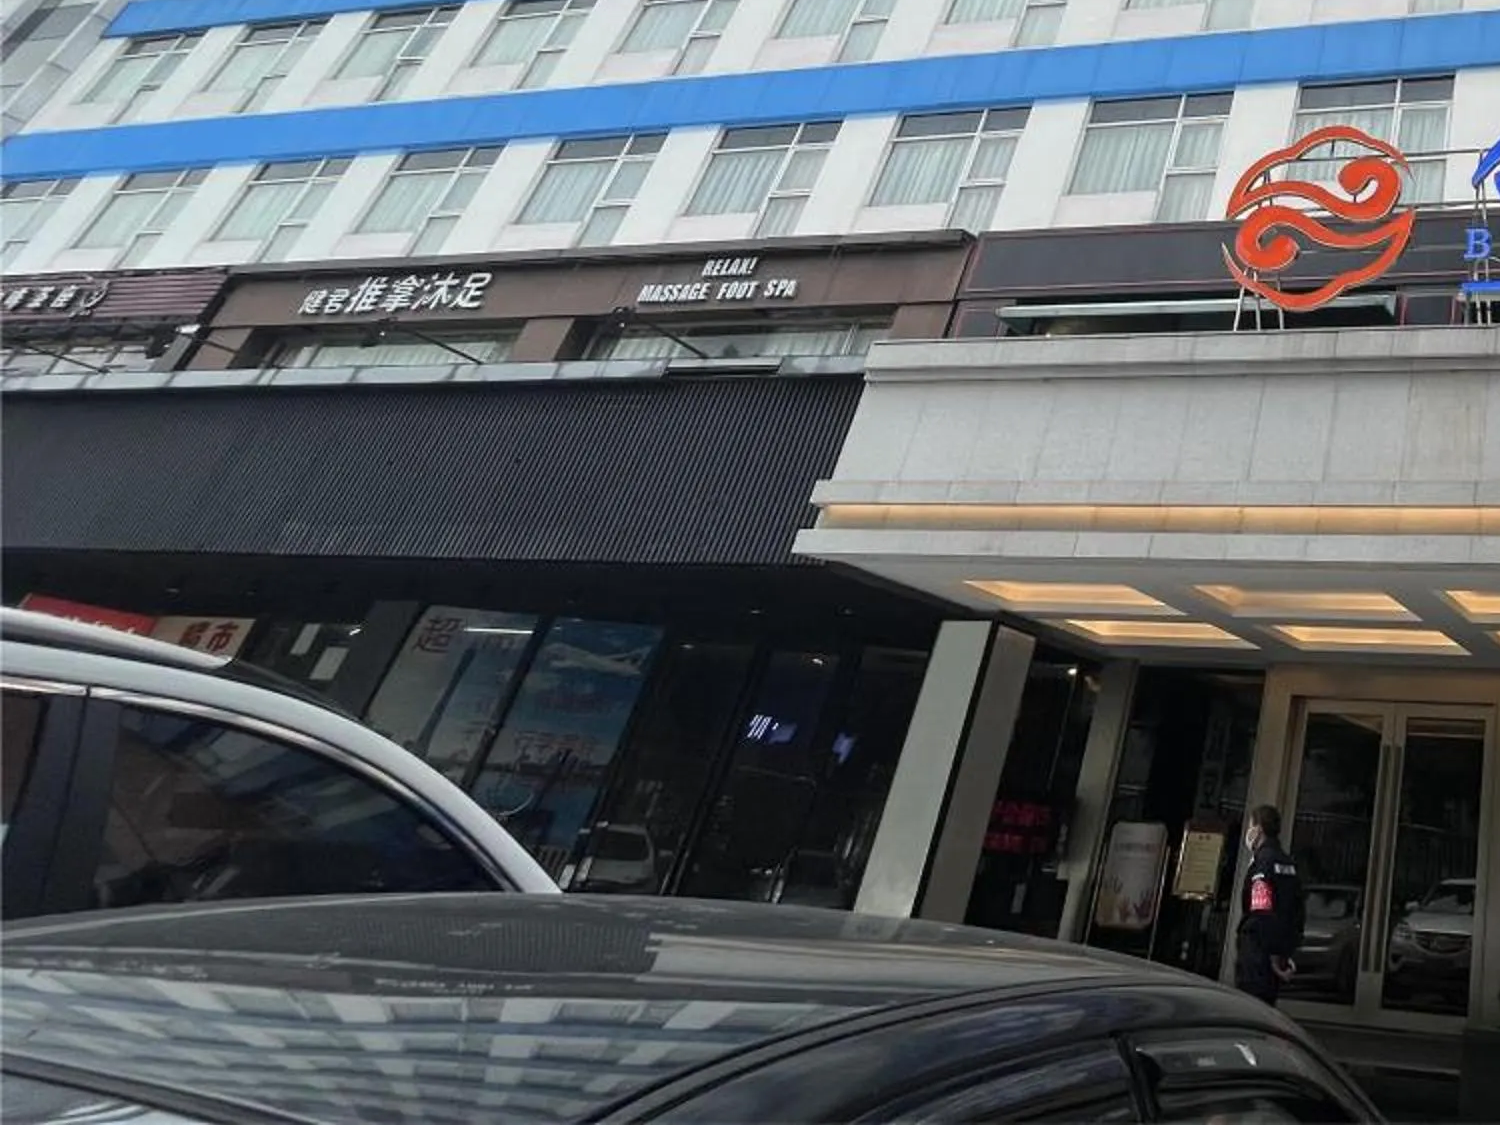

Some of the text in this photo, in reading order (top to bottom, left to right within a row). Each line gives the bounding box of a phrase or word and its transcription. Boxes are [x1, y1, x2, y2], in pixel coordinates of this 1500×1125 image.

[636, 279, 798, 302] MASSAGE FOOT SPA
